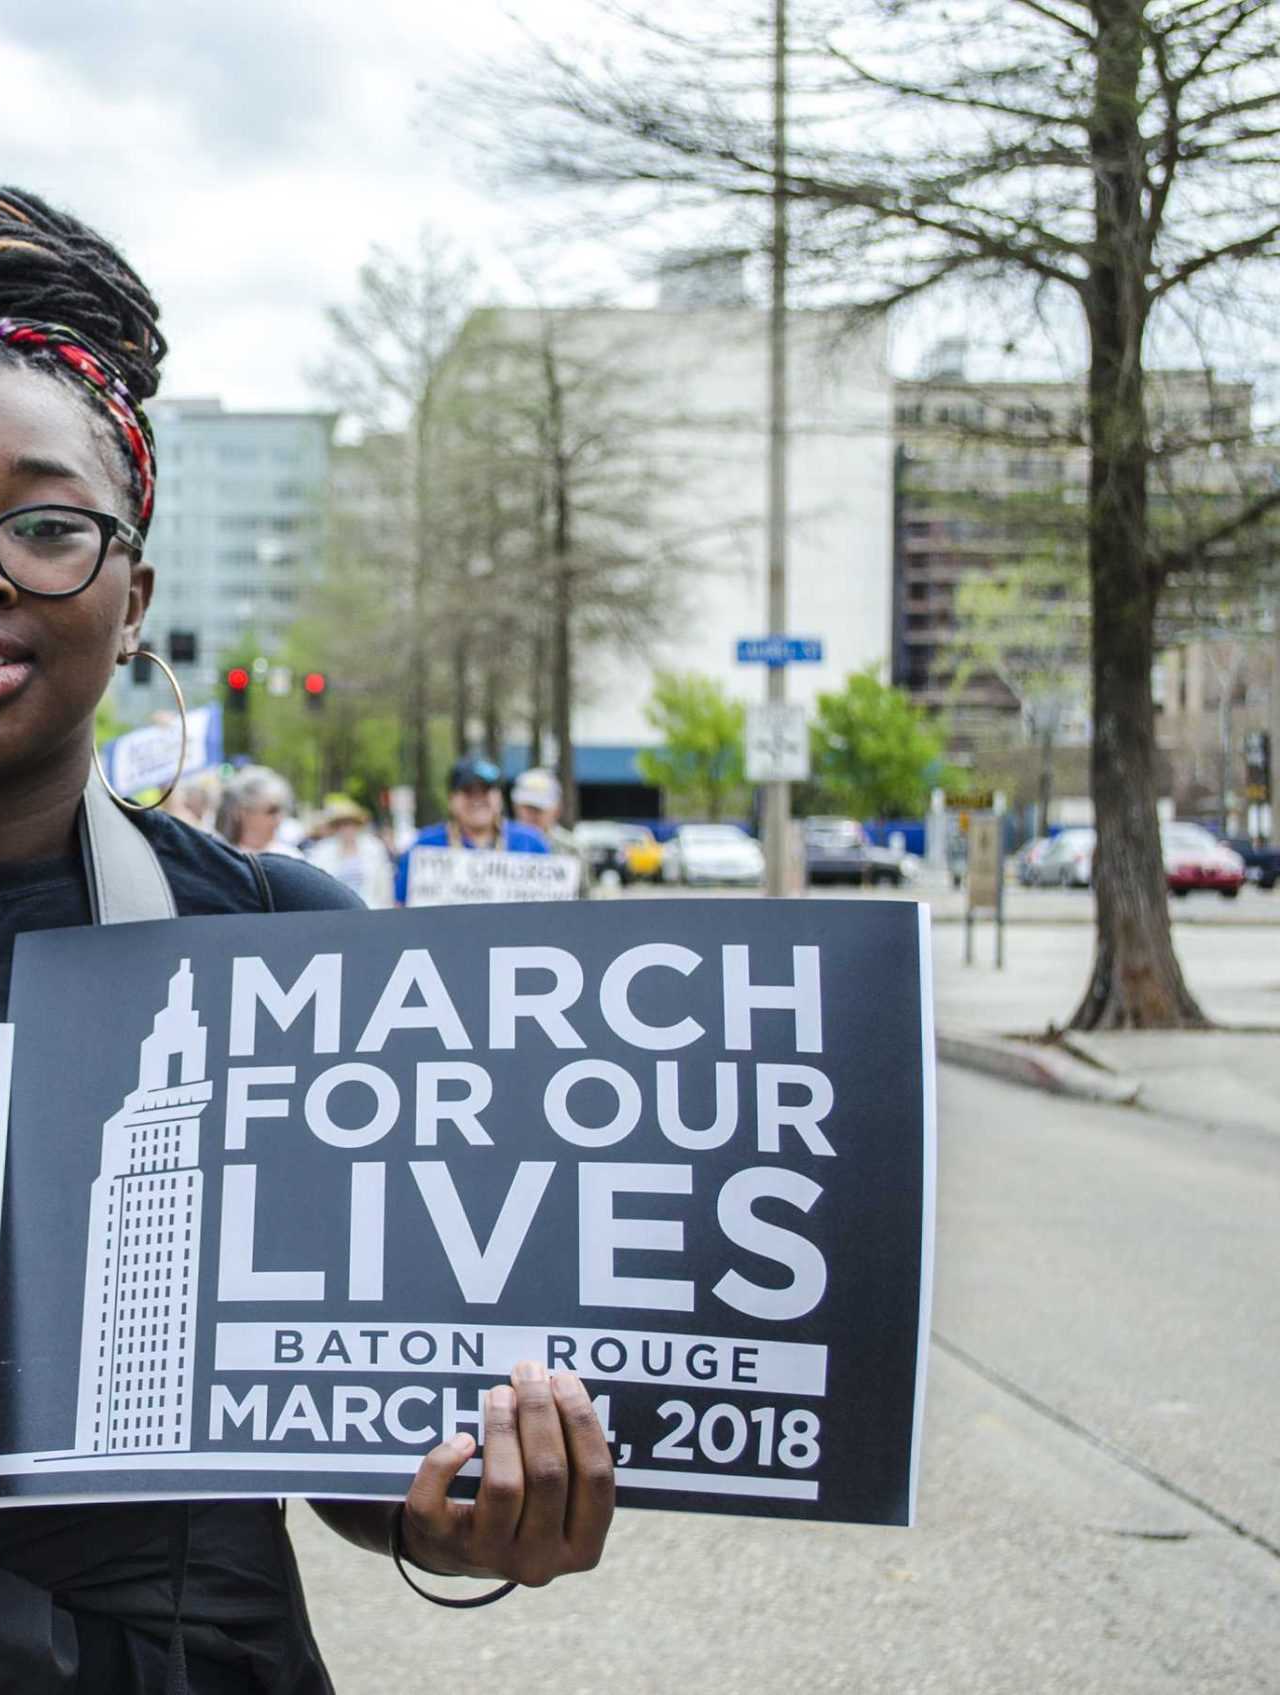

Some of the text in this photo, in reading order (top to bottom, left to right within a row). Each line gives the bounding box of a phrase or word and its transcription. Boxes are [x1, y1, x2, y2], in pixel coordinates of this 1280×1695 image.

[228, 942, 824, 1057] MARCH
[223, 1058, 838, 1157] FOR OUR
[216, 1160, 828, 1321] LIVES
[273, 1329, 759, 1384] BATON ROUGE
[208, 1384, 486, 1446] MARCH
[651, 1399, 821, 1470] 2018
